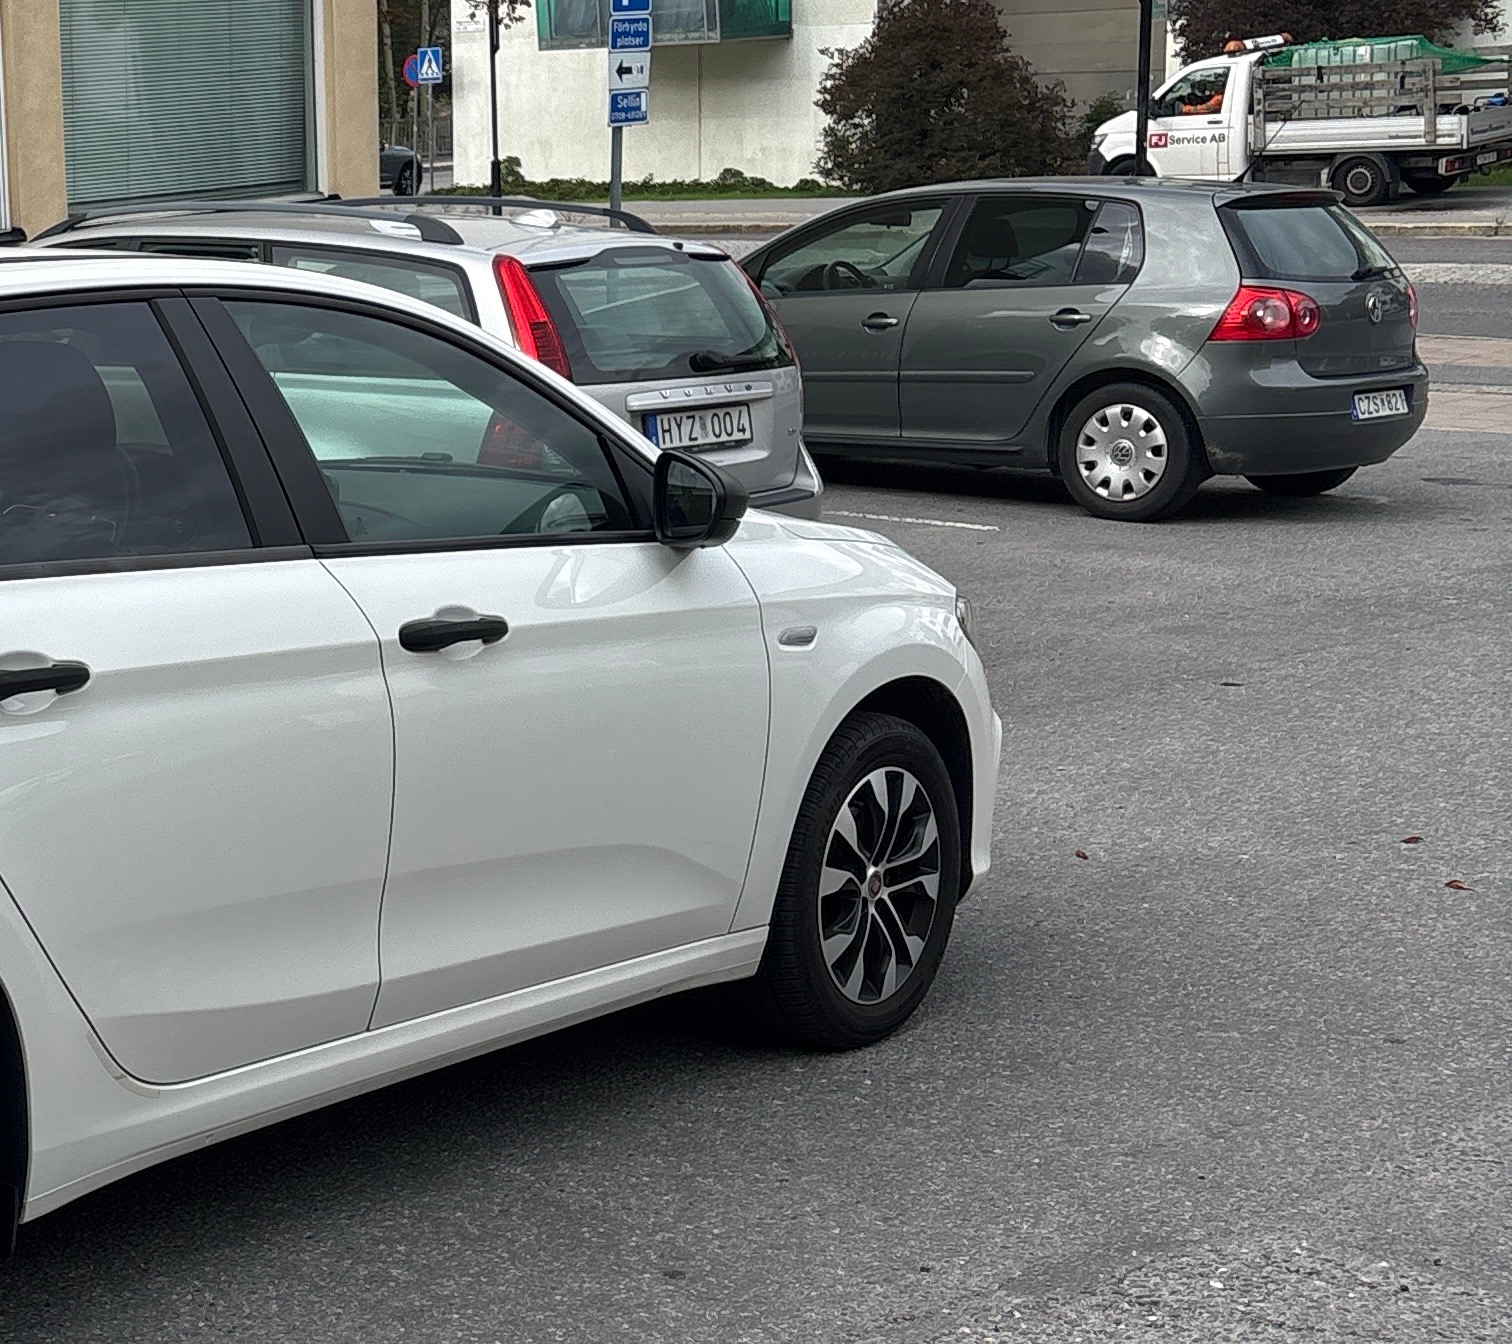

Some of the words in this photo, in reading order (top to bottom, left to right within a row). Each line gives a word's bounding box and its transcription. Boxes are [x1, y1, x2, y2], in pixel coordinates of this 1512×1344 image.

[1151, 135, 1166, 147] FJ
[1168, 134, 1208, 146] Service
[1209, 132, 1226, 144] AB
[659, 383, 753, 400] VOLVO
[1357, 396, 1381, 416] CZS
[659, 415, 699, 446] HYZ
[710, 409, 747, 439] 004
